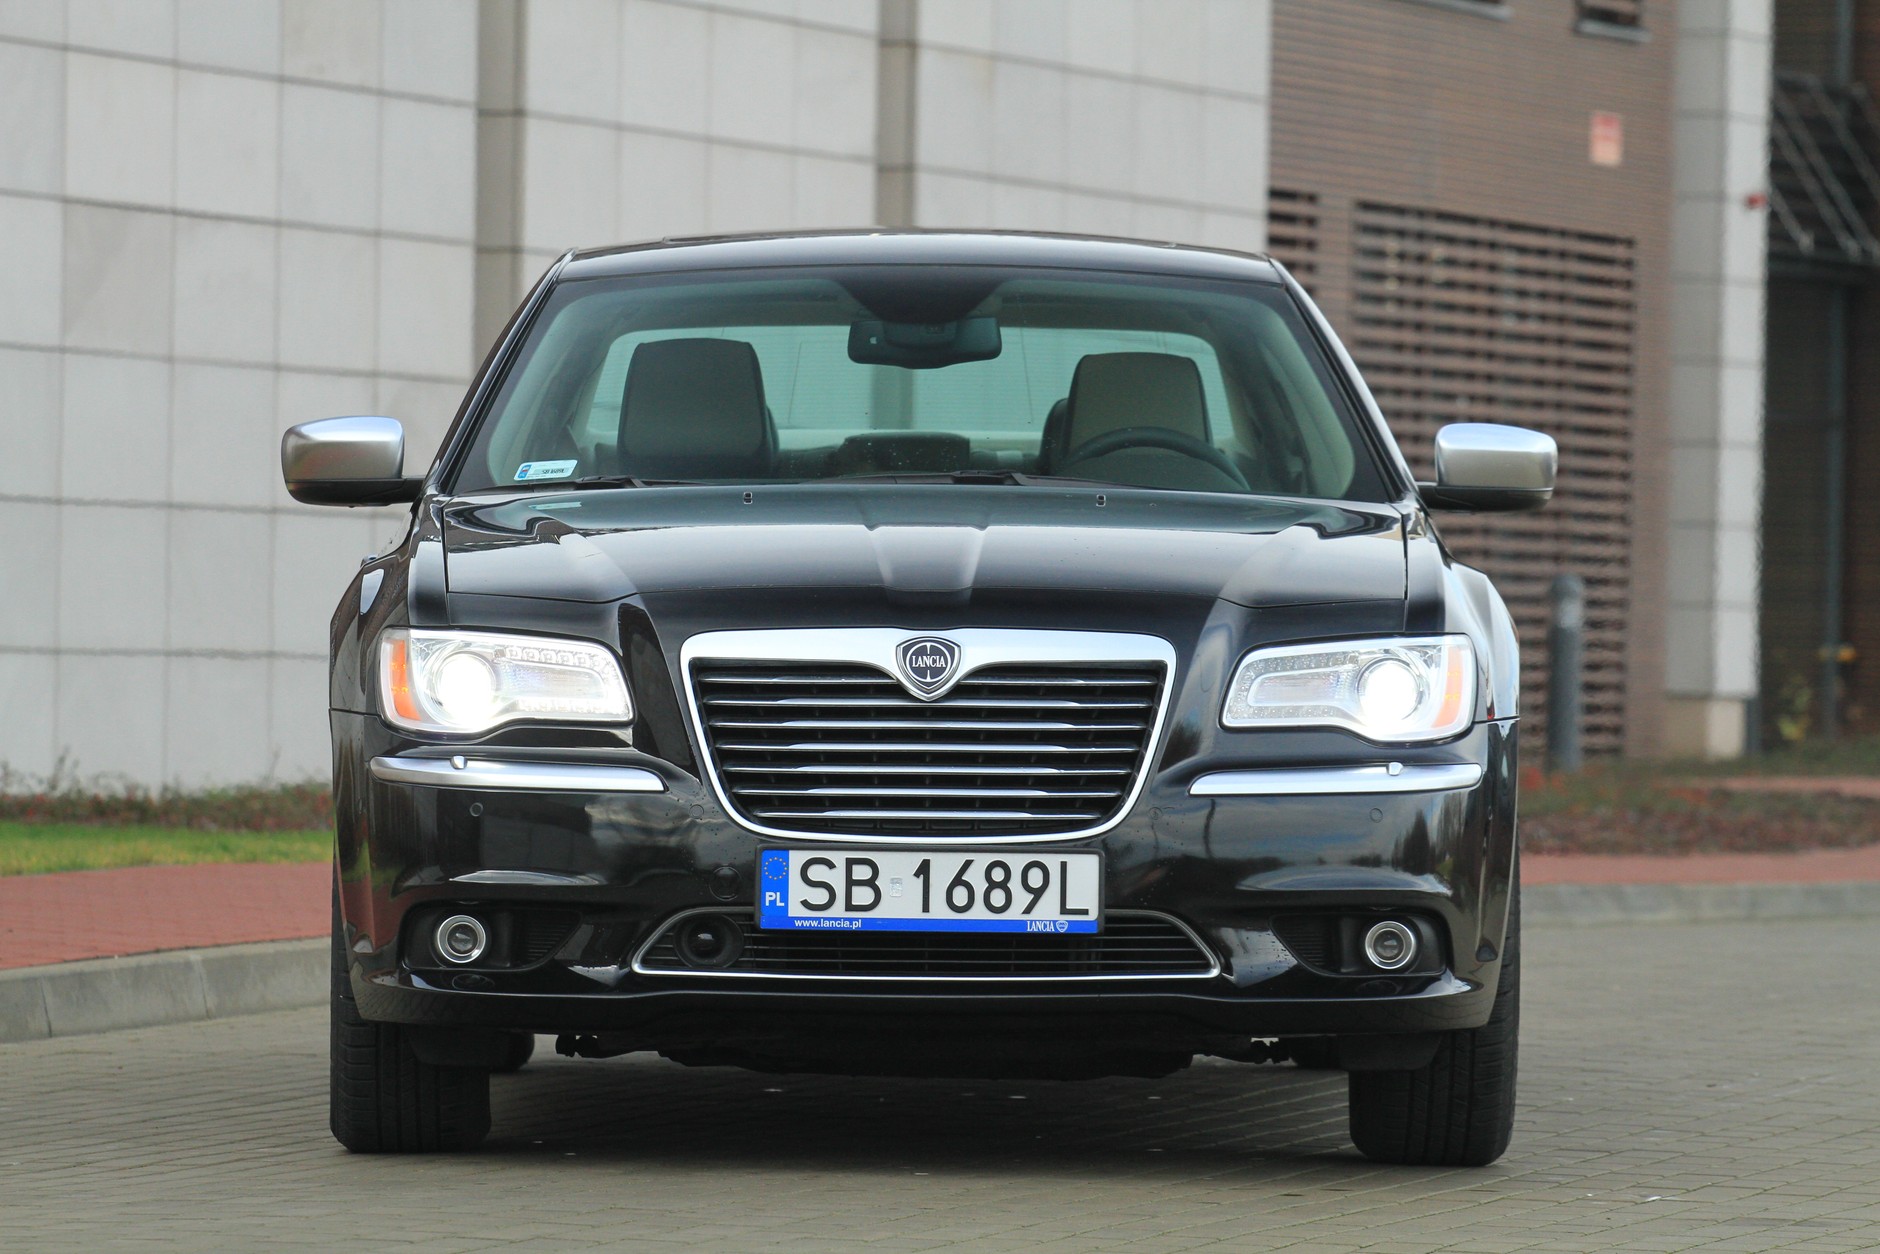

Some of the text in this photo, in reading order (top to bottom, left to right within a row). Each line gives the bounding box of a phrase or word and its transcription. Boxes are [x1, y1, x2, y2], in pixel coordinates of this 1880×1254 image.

[912, 655, 946, 667] LANCIA
[800, 857, 1089, 915] SB 1689L
[765, 891, 785, 907] PL
[794, 919, 861, 930] www.lancia.pl
[1027, 920, 1055, 932] LANCIA
